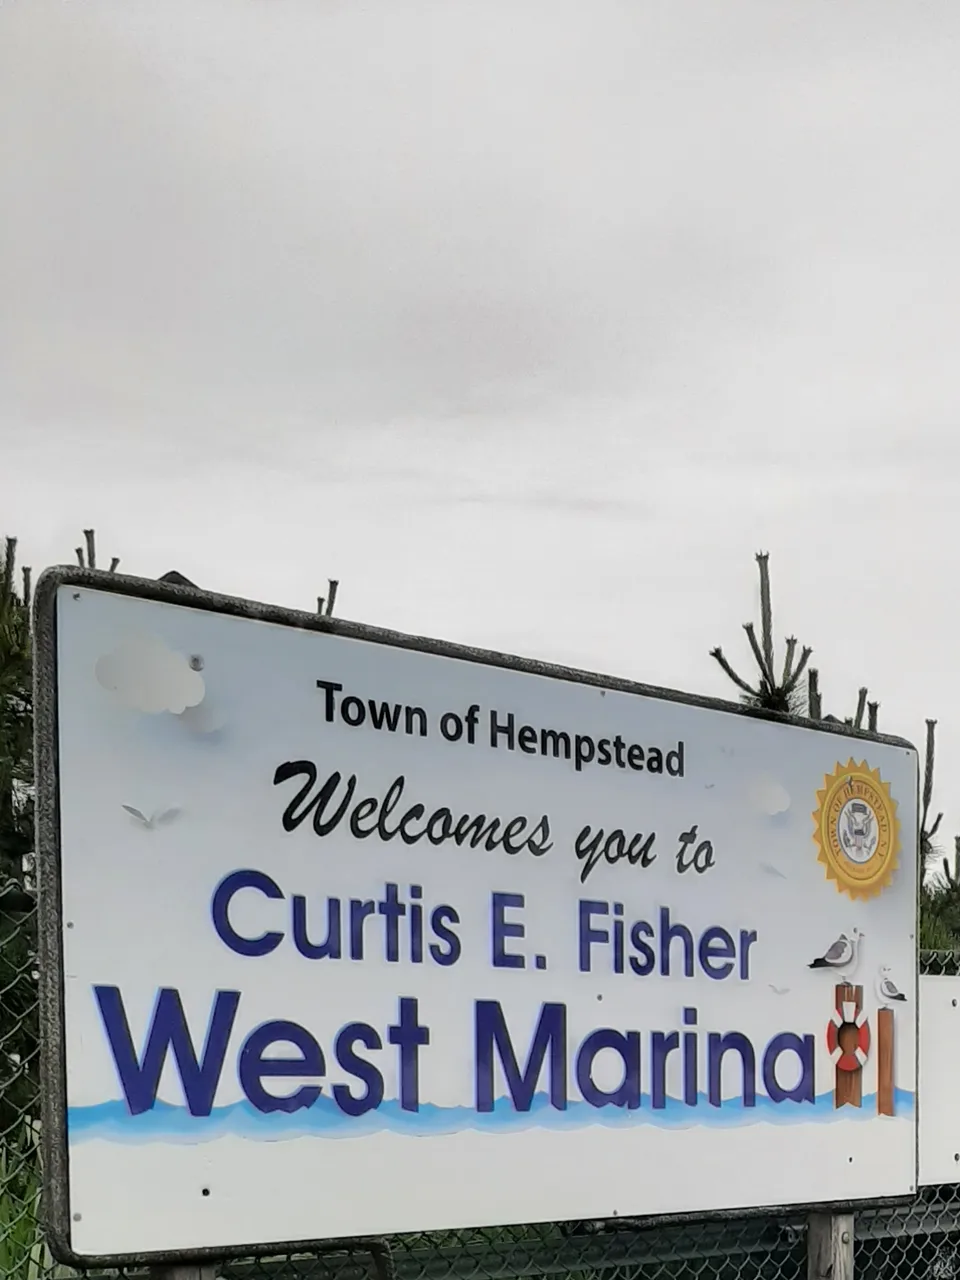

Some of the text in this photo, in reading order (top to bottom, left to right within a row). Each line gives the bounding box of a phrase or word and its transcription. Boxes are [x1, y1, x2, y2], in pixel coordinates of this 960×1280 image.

[316, 680, 685, 777] Town of Hempstead
[273, 760, 716, 883] Welcomes you to
[211, 869, 757, 980] Curtis E. Fisher
[92, 984, 815, 1117] West Marina
